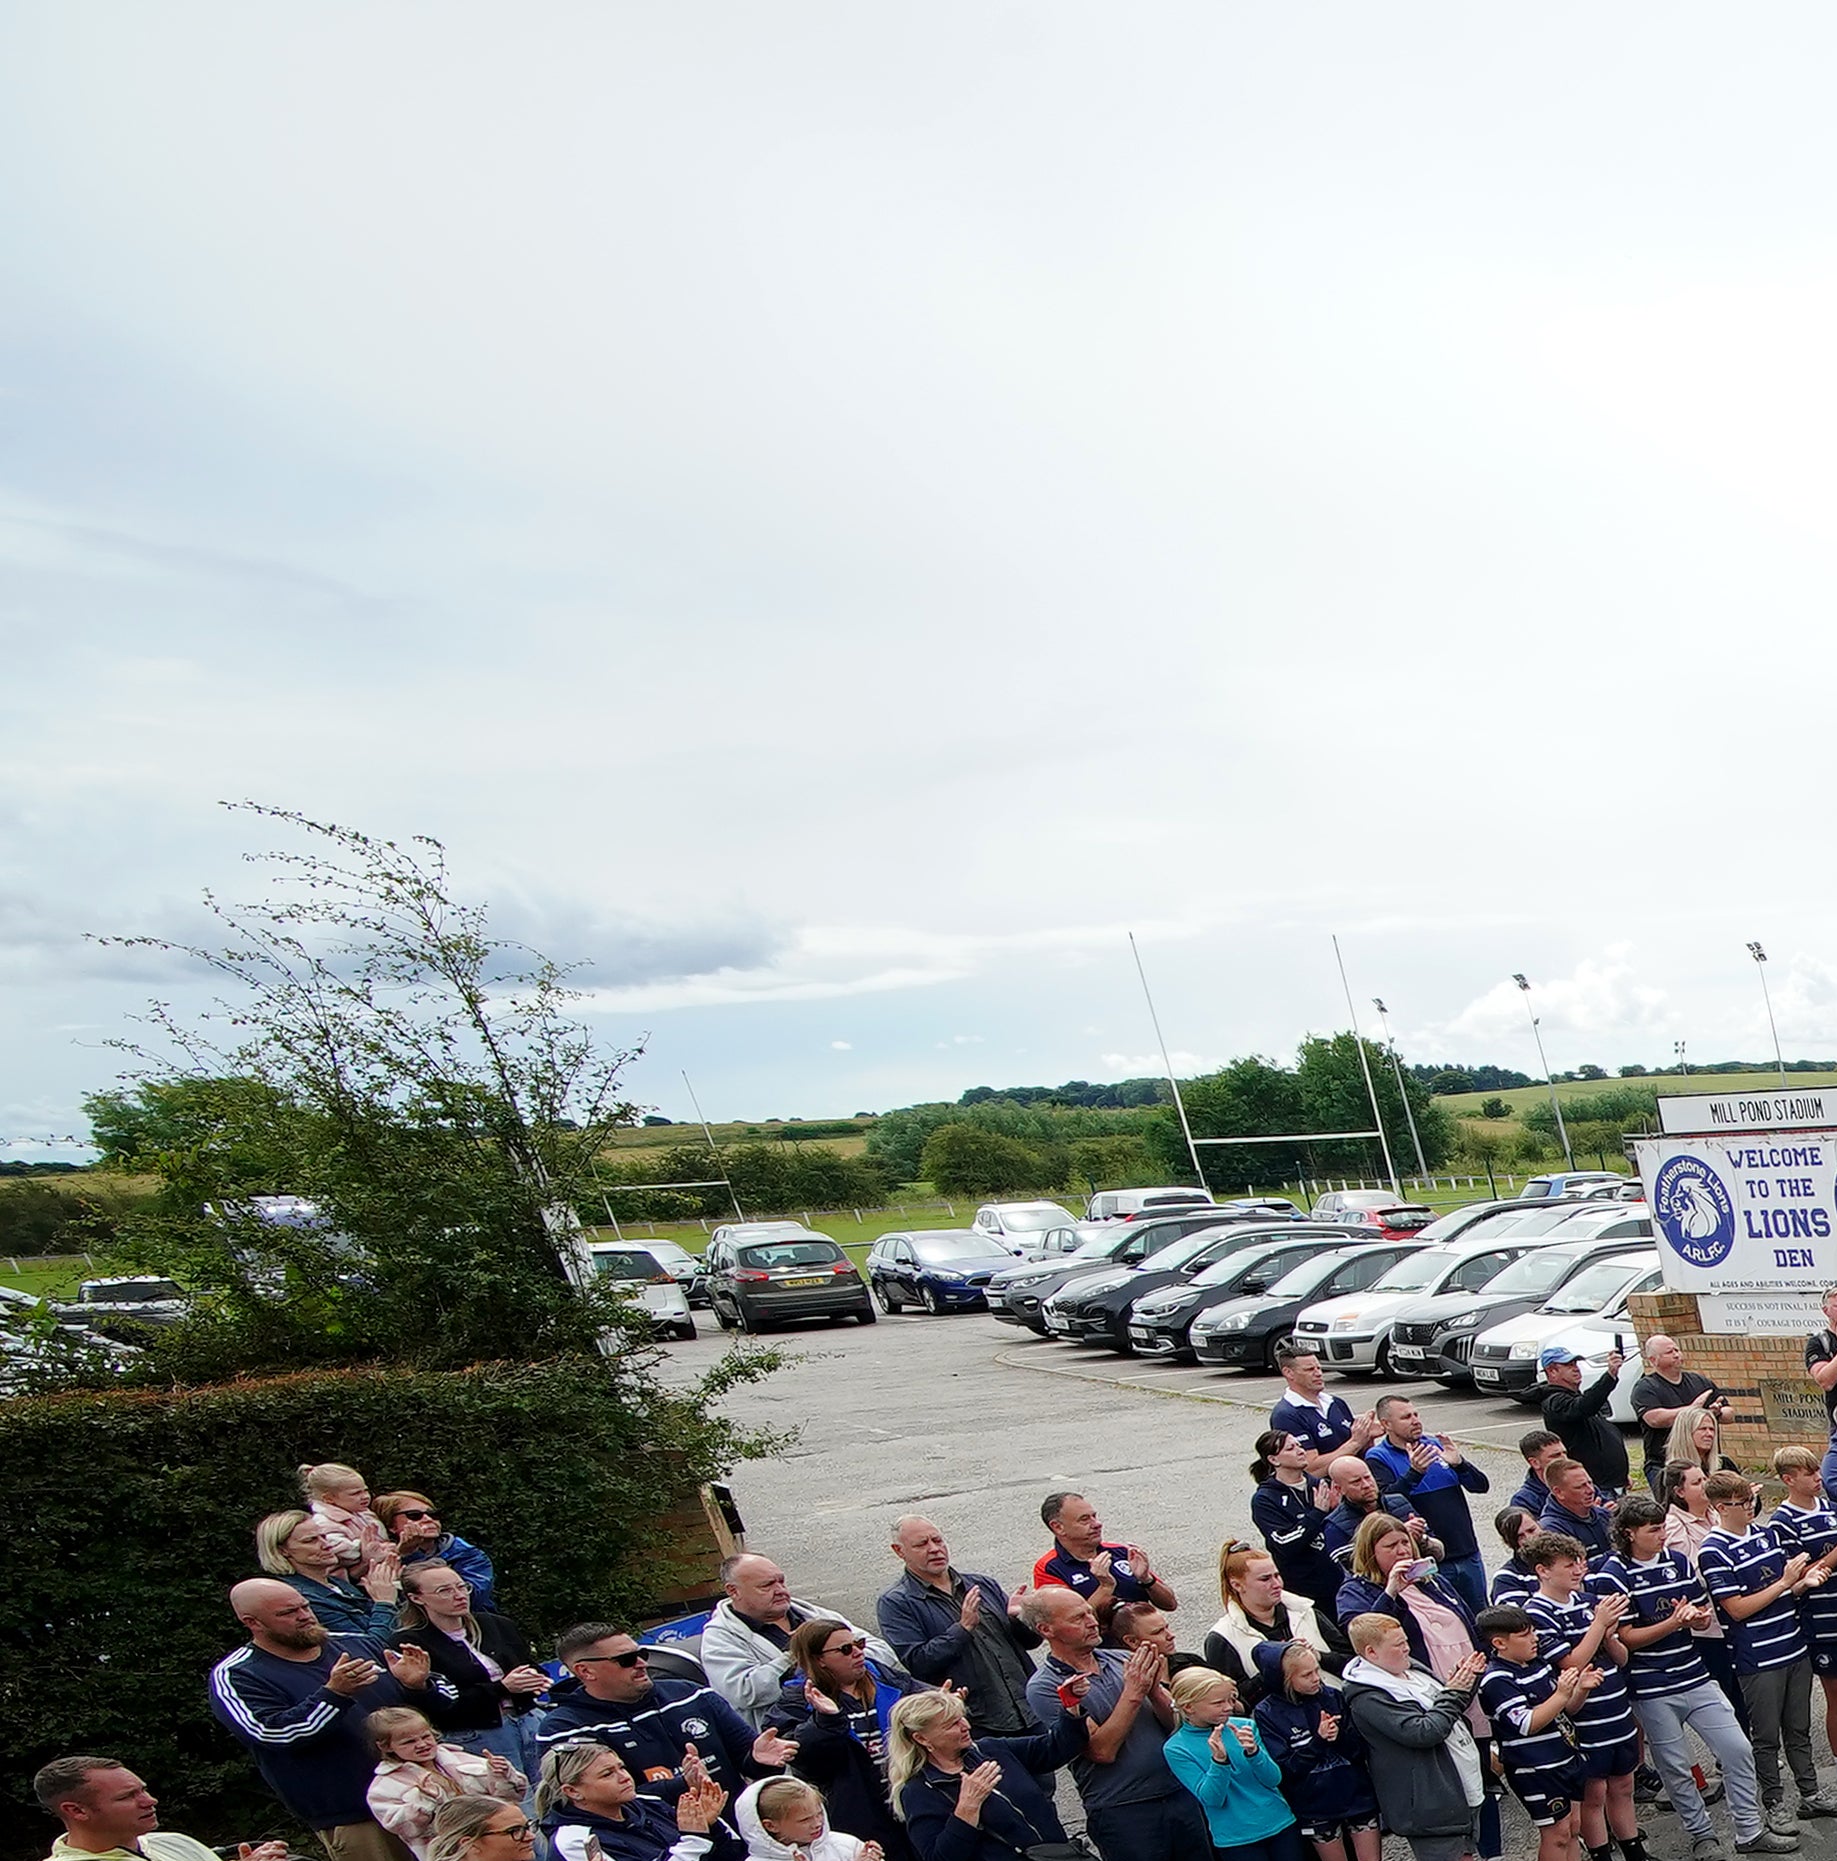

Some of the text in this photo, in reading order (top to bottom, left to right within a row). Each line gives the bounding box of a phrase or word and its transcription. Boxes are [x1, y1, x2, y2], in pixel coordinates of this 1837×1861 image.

[1710, 1098, 1824, 1123] MILL POND STADIUM
[1726, 1147, 1823, 1168] WELCOME
[1707, 1174, 1730, 1213] Lions
[1746, 1178, 1815, 1199] TO THE
[1743, 1207, 1831, 1239] LIONS
[1773, 1249, 1815, 1267] DEN
